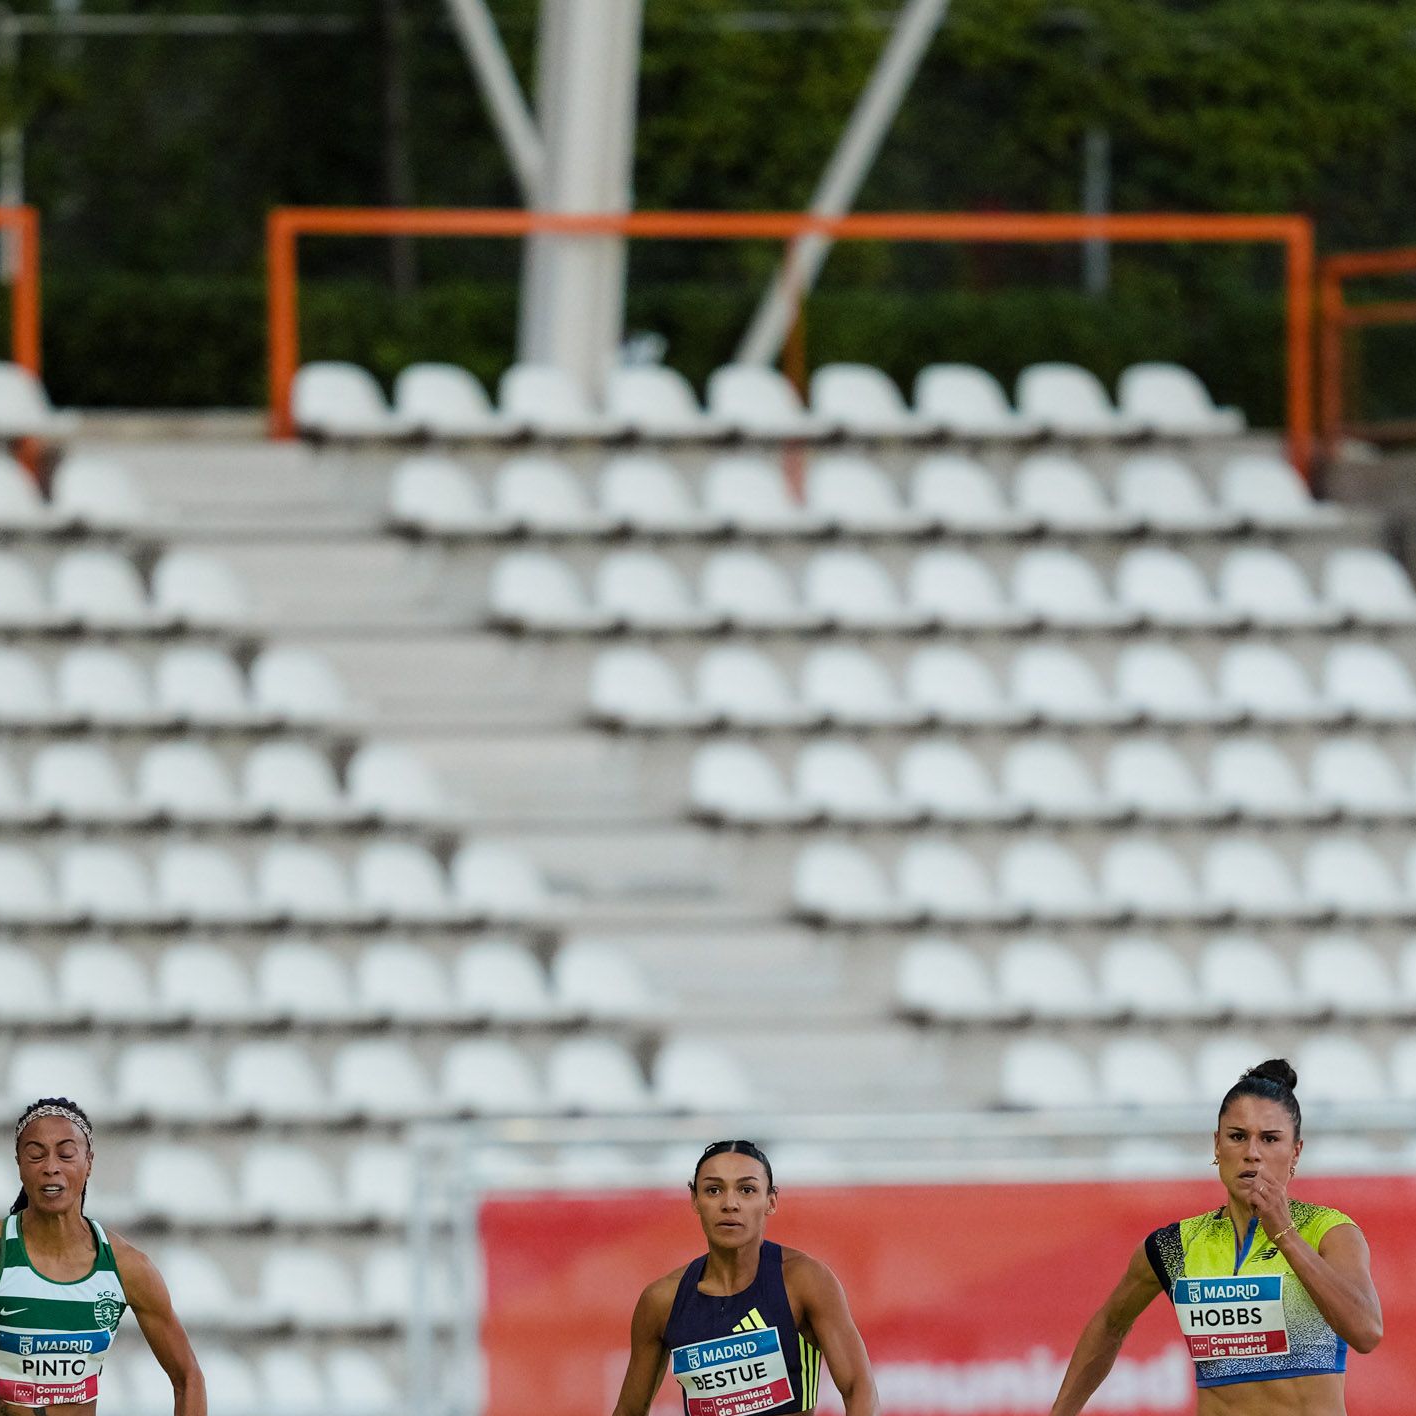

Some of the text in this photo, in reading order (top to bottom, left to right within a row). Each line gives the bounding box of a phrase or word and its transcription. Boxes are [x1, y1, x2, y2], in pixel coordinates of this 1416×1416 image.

[97, 1290, 117, 1298] SCP
[1204, 1284, 1260, 1300] MADRID
[1190, 1307, 1263, 1327] HOBBS
[35, 1339, 93, 1354] MADRID
[1210, 1334, 1267, 1345] Comunidad
[703, 1341, 758, 1364] MADRID
[1212, 1344, 1268, 1357] de Madrid
[22, 1359, 86, 1377] PINTO
[691, 1362, 768, 1391] BESTUE
[36, 1381, 86, 1394] Comunidad
[36, 1391, 87, 1404] de Madrid
[715, 1386, 772, 1407] Comunidad
[718, 1395, 775, 1416] de Madrid
